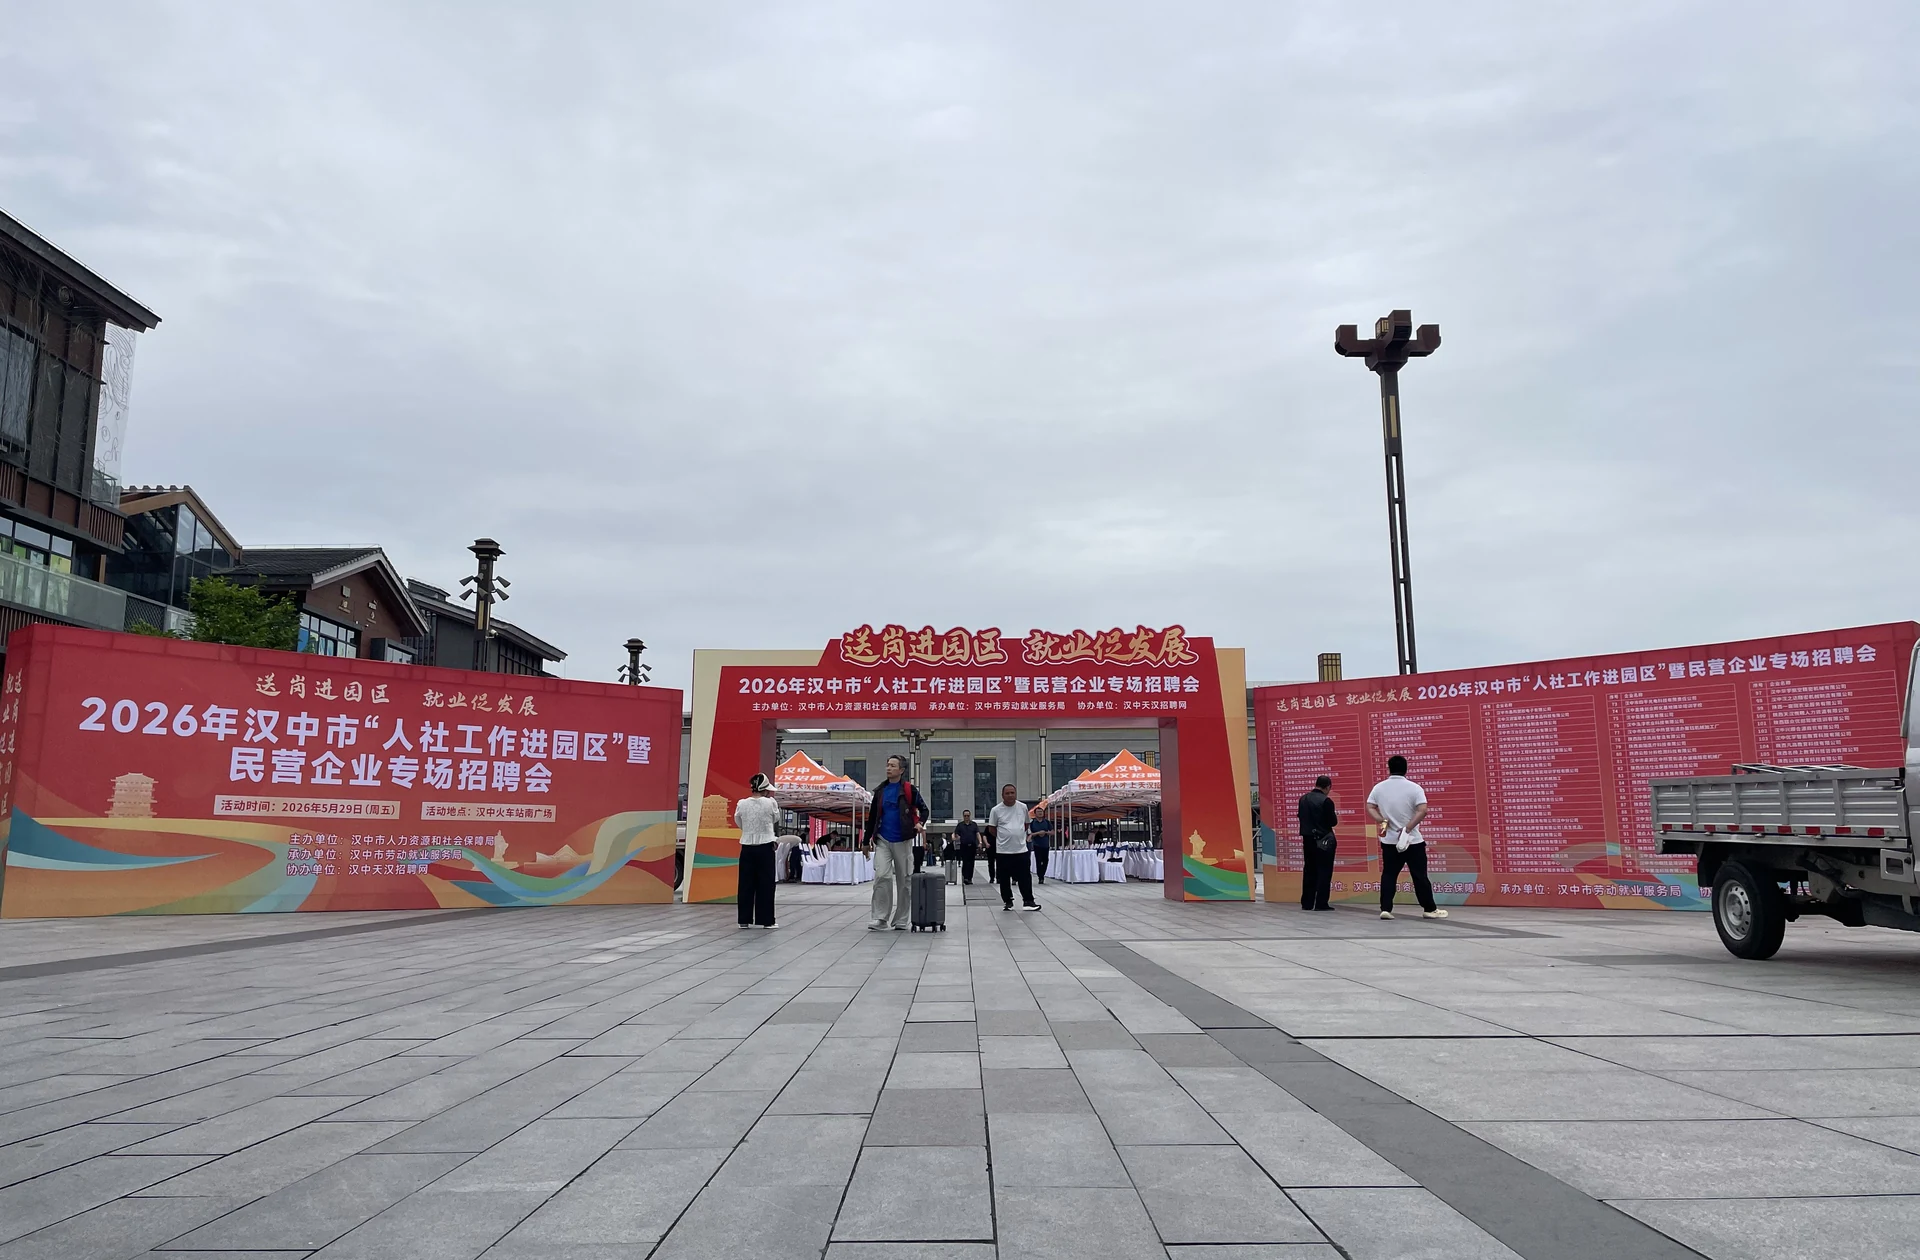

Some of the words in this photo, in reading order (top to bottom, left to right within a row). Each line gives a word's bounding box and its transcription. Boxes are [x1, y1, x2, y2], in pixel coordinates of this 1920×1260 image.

[842, 627, 1004, 665] 送岗进园区
[1024, 625, 1197, 664] 就业促发展
[738, 675, 1200, 696] 2026年汉中市“人社工作进园区”暨民营企业专场招聘会
[1276, 693, 1338, 713] 送岗进园区
[1345, 687, 1413, 706] 就业促发展
[1417, 644, 1877, 701] 2026年汉中市“人社工作进园区”暨民营企业专场招聘会
[255, 672, 391, 704] 送岗进园区
[421, 688, 539, 717] 就业促发展
[78, 696, 652, 765] 2026年汉中市“人社工作进园区”暨
[229, 746, 553, 794] 民营企业专场招聘会
[425, 804, 553, 819] 活动地点：汉中火车站南广场
[289, 833, 496, 848] 主办单位：汉中市人力资源和社会保障局
[287, 848, 463, 861] 承办单位：汉中市劳动就业服务局
[286, 863, 429, 876] 协办单位：汉中天汉招聘网
[1500, 883, 1682, 896] 承办单位：汉中市劳动就业服务局
